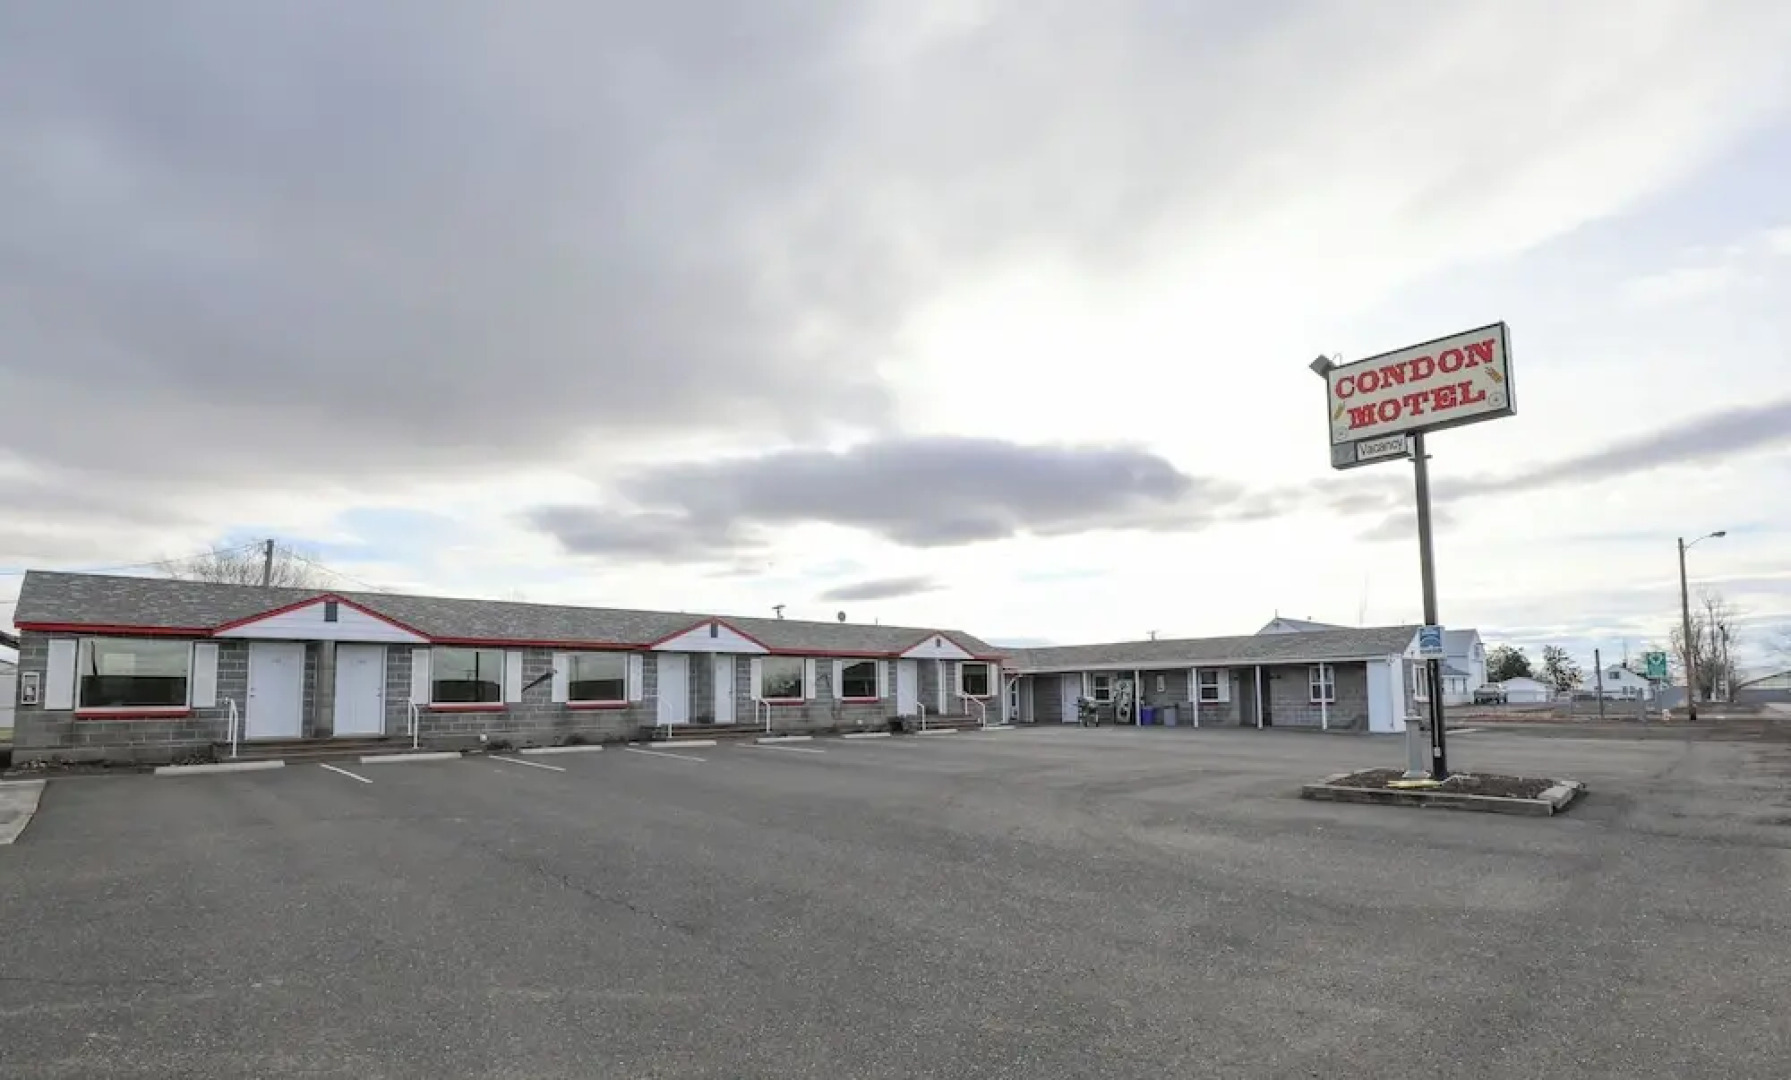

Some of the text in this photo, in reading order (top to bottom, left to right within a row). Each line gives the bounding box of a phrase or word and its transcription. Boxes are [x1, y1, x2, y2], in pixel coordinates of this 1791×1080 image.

[1335, 338, 1496, 399] CONDON
[1347, 380, 1486, 430] MOTEL
[1358, 438, 1404, 457] Vacancy
